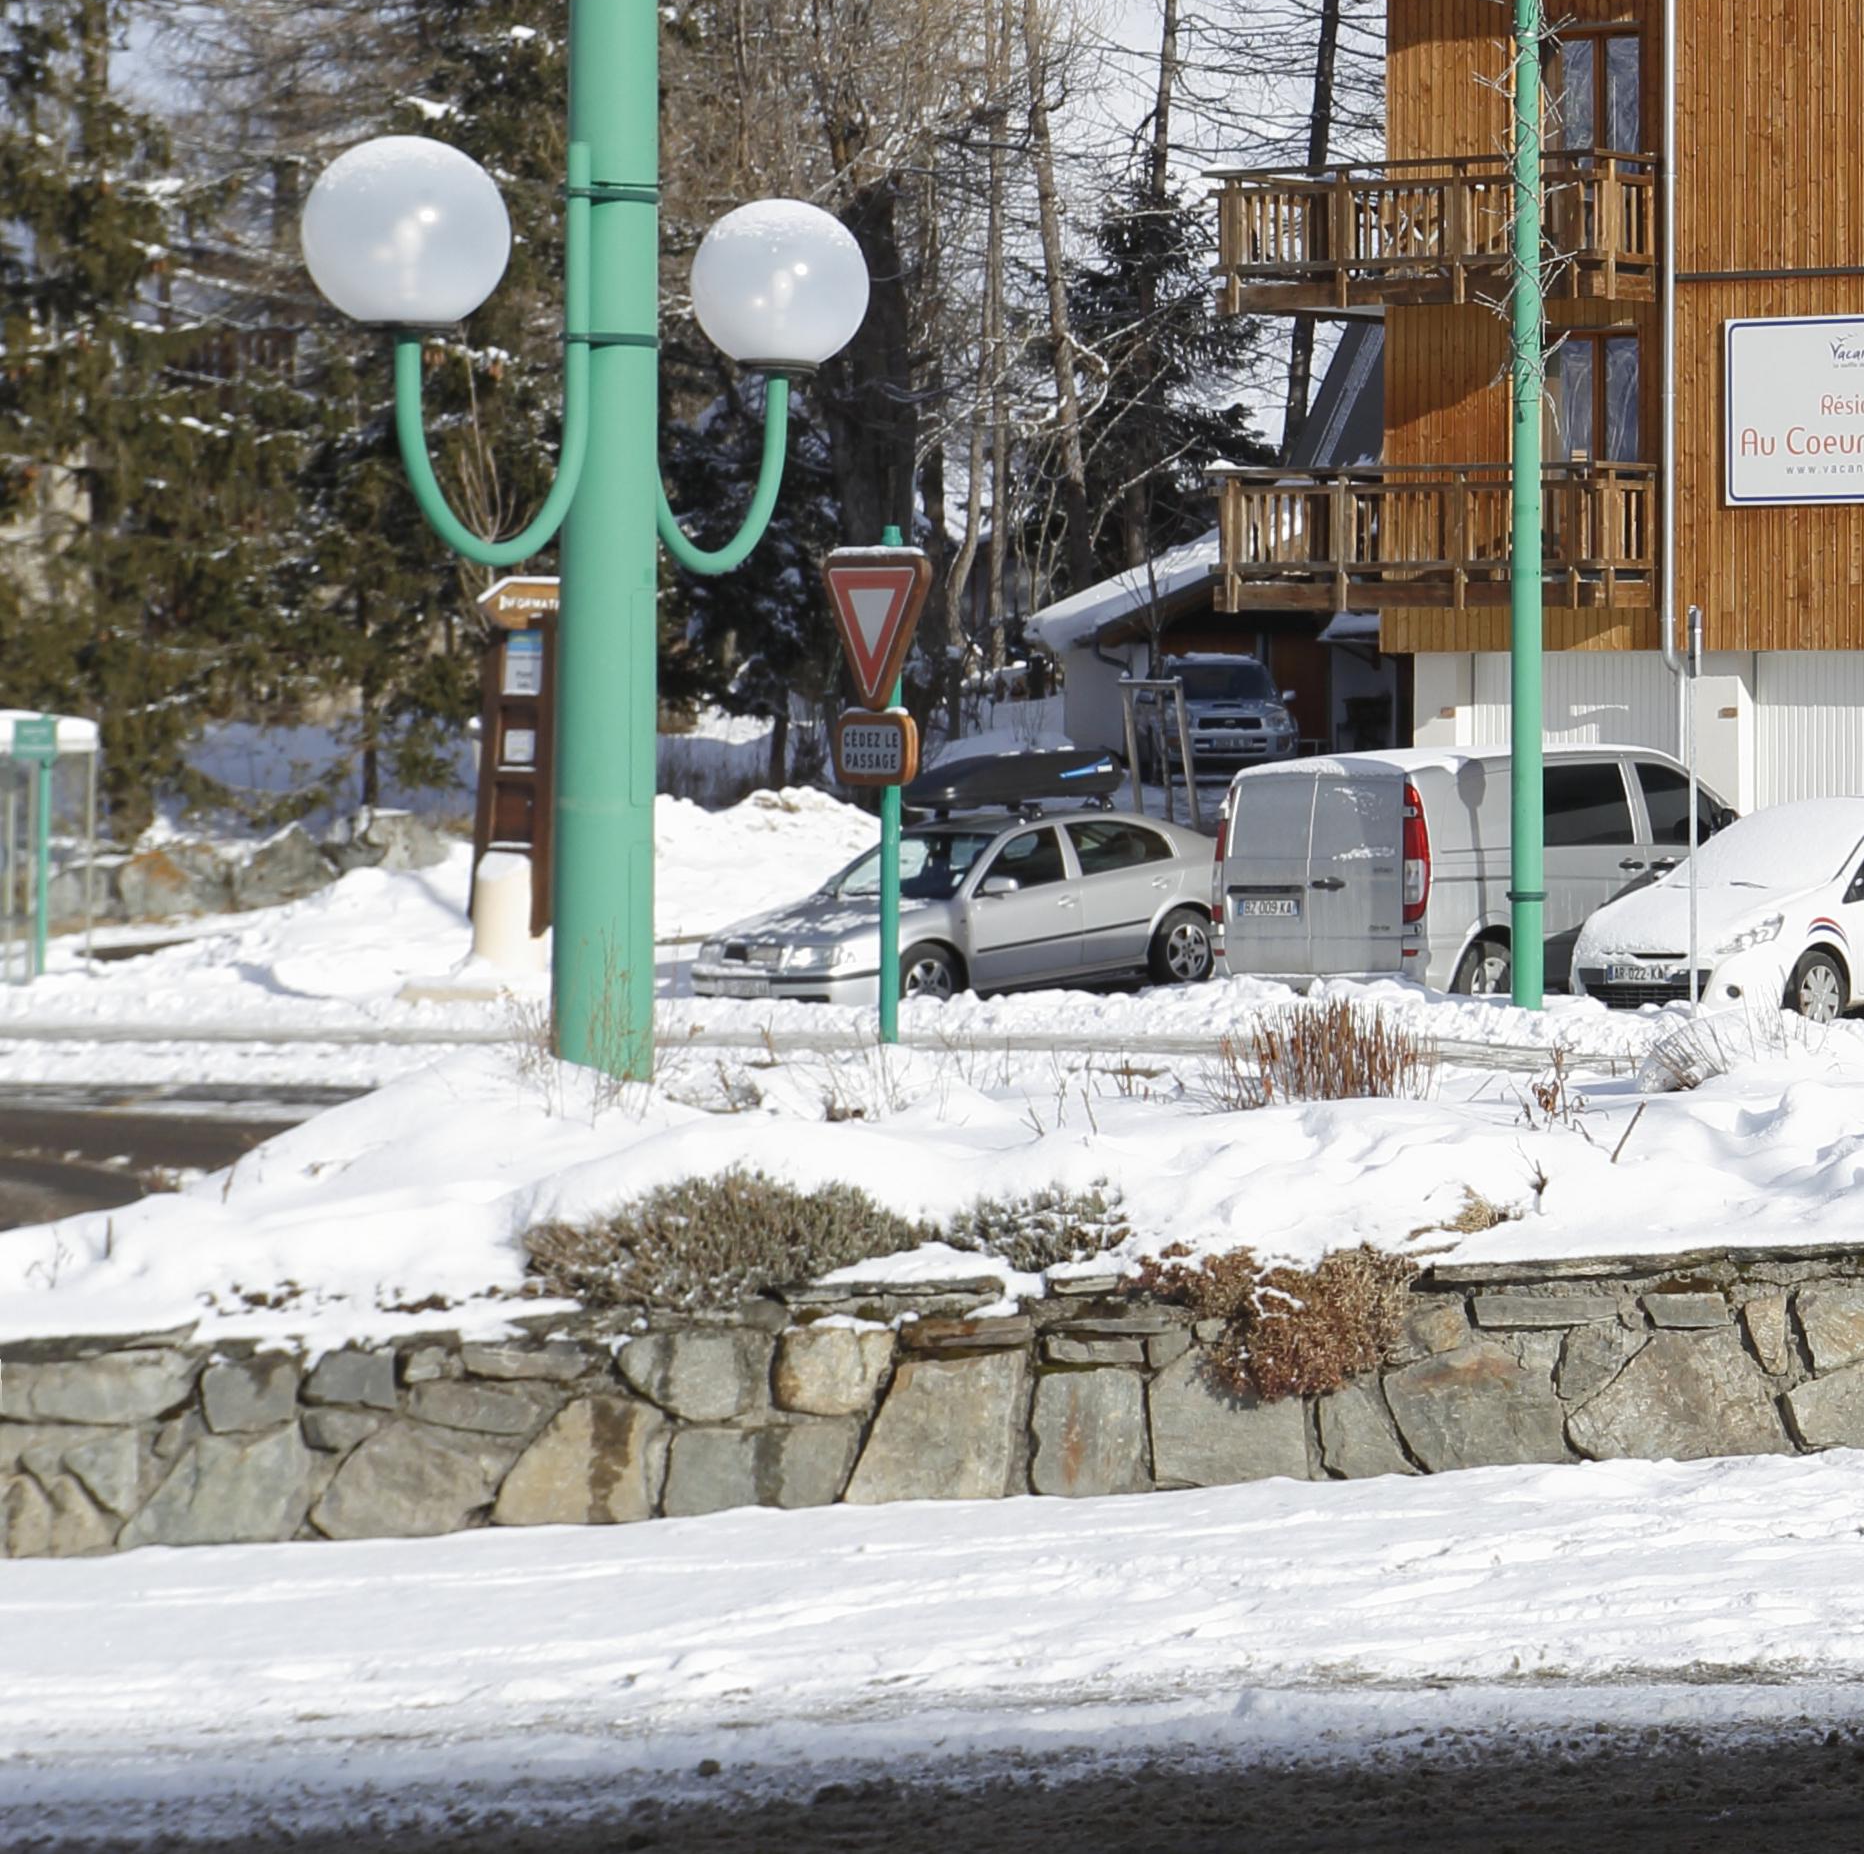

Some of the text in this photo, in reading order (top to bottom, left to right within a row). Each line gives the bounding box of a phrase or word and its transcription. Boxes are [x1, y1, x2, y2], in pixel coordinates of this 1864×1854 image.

[1740, 427, 1776, 457] Au
[885, 732, 899, 748] LE
[845, 752, 897, 770] PASSAGE
